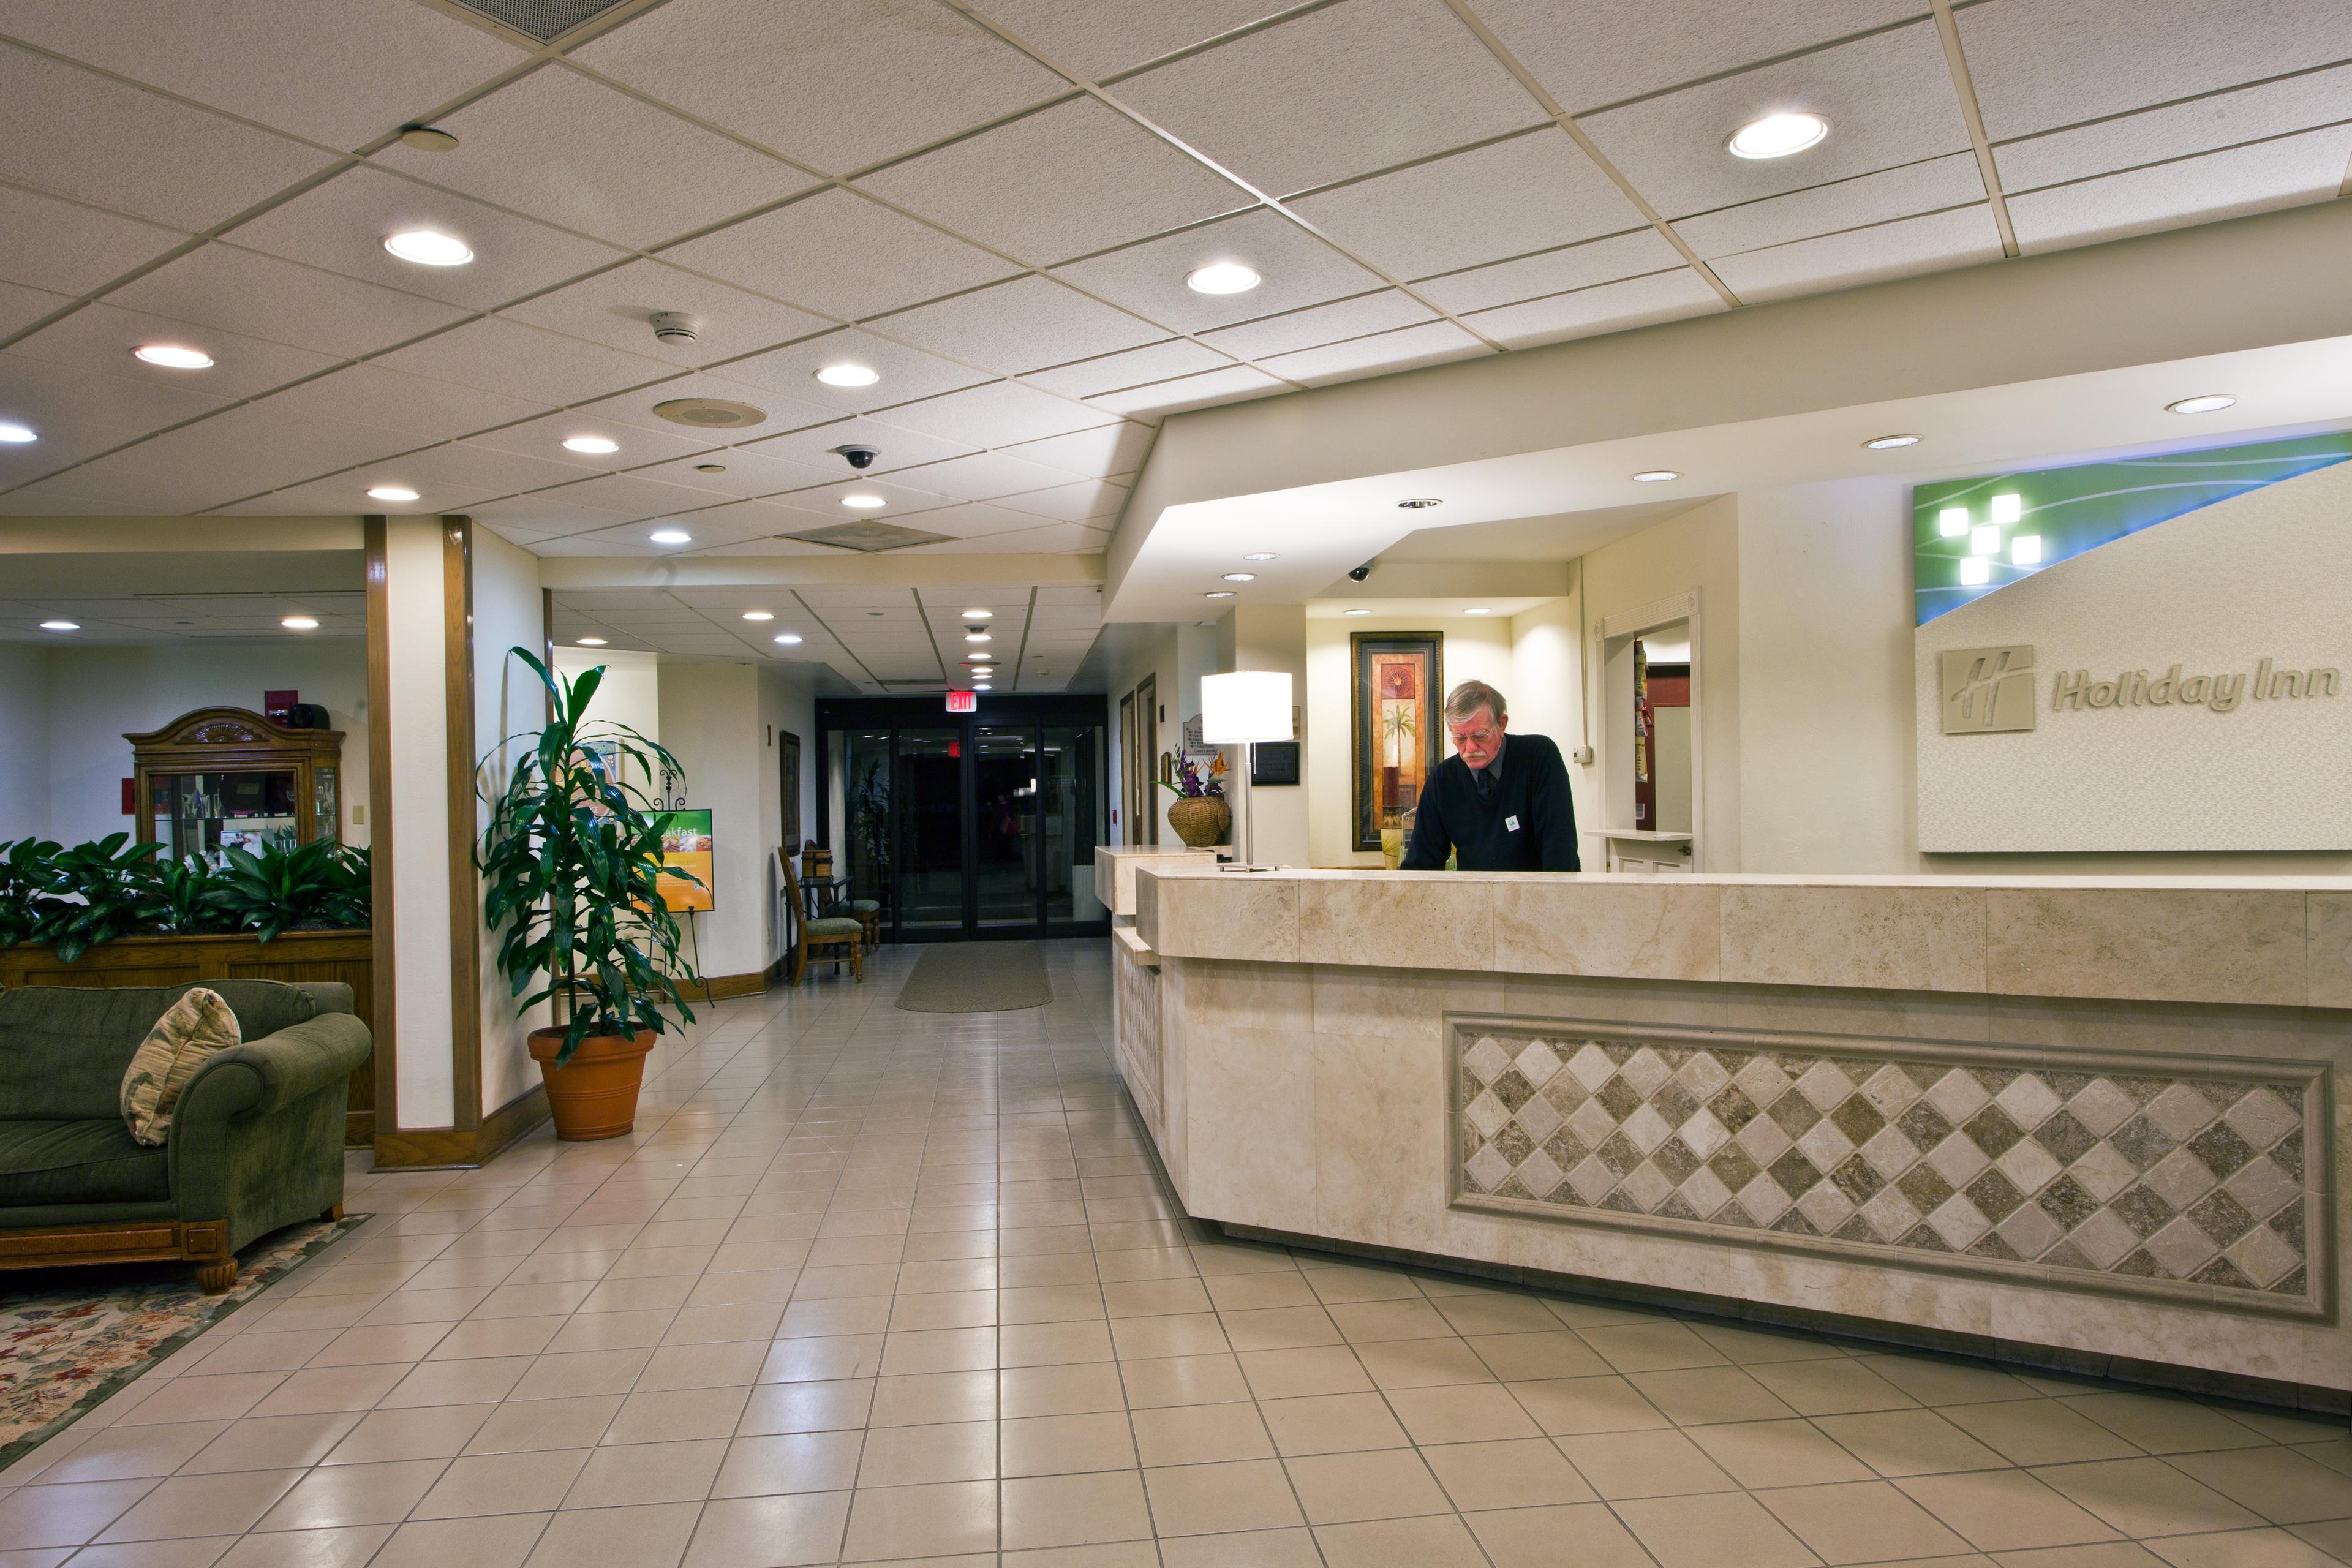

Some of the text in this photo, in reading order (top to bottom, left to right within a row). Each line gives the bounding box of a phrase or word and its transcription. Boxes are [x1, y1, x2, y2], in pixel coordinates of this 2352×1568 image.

[2052, 657, 2341, 712] Holiday Inn
[951, 692, 972, 710] EXIT
[665, 827, 698, 837] akfast
